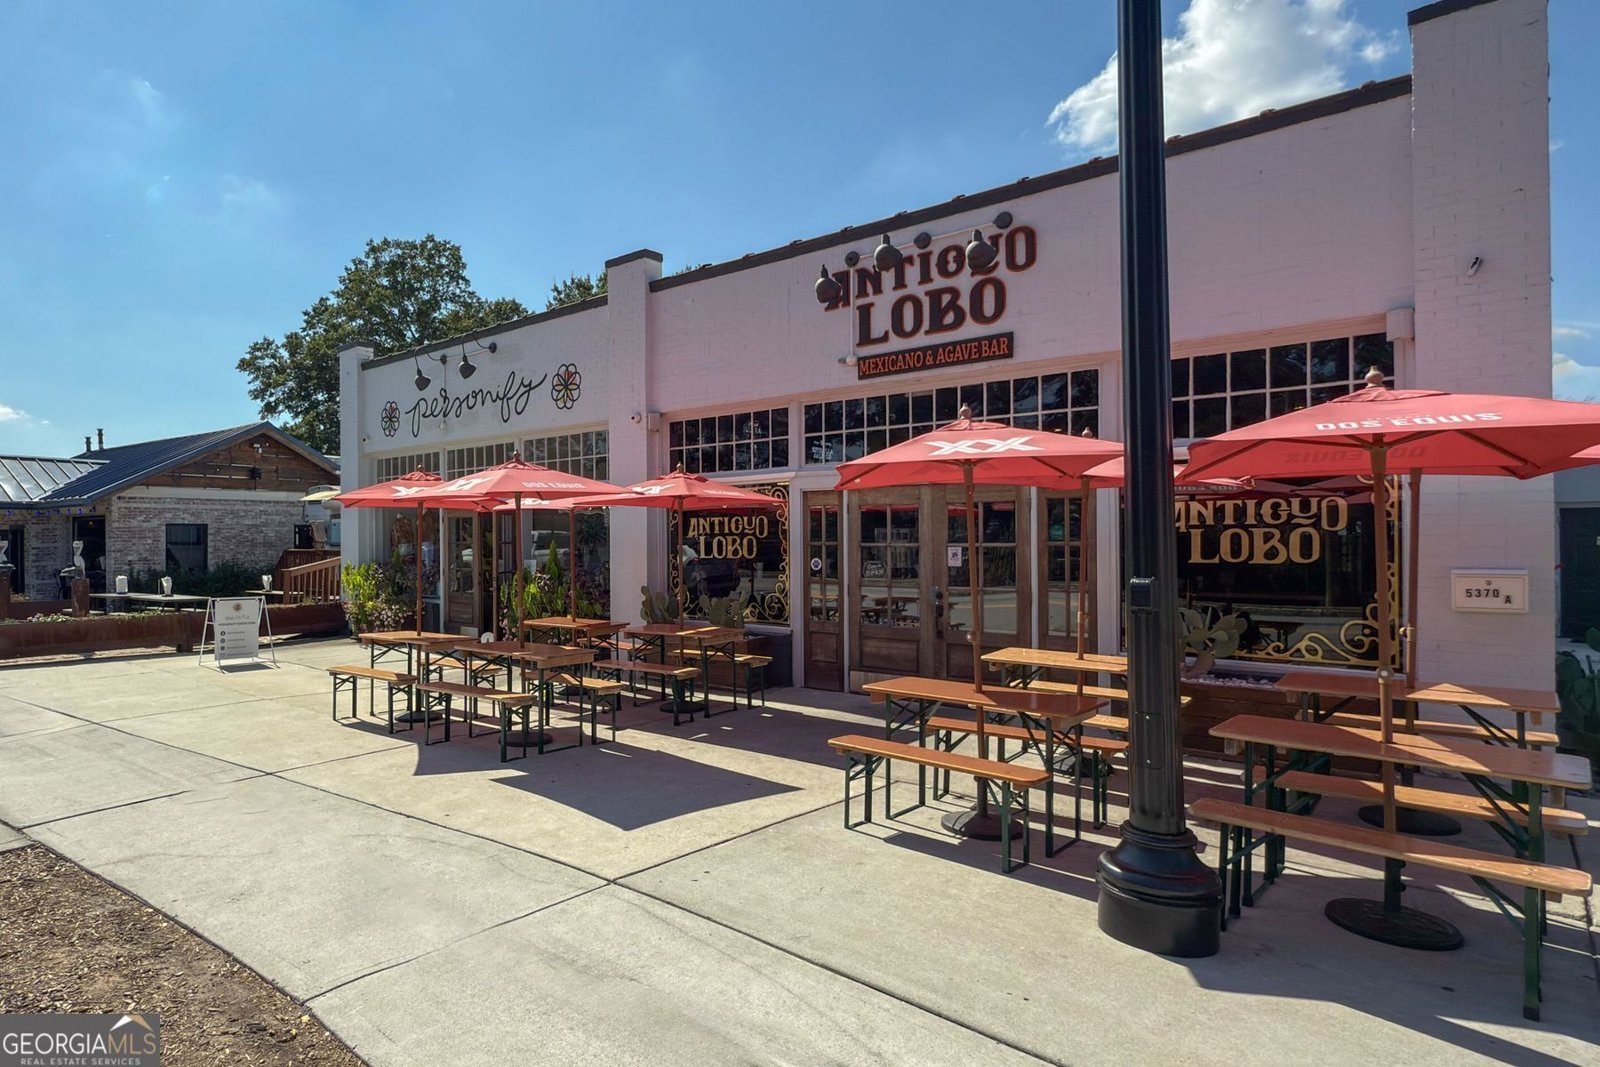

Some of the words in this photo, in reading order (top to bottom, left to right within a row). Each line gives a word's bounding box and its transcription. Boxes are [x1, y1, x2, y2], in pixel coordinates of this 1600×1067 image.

[856, 276, 1006, 348] LOBO
[859, 350, 923, 376] MEXICANO
[925, 350, 934, 365] &
[936, 341, 979, 364] AGAVE
[981, 337, 1009, 357] BAR
[405, 370, 548, 438] personify
[1315, 420, 1382, 431] DOS
[1390, 412, 1504, 427] EQUIS
[686, 515, 769, 538] ANTIGUO
[699, 535, 757, 559] LOBO
[1188, 526, 1321, 565] LOBO
[1465, 588, 1499, 598] 5370
[1504, 594, 1512, 604] A
